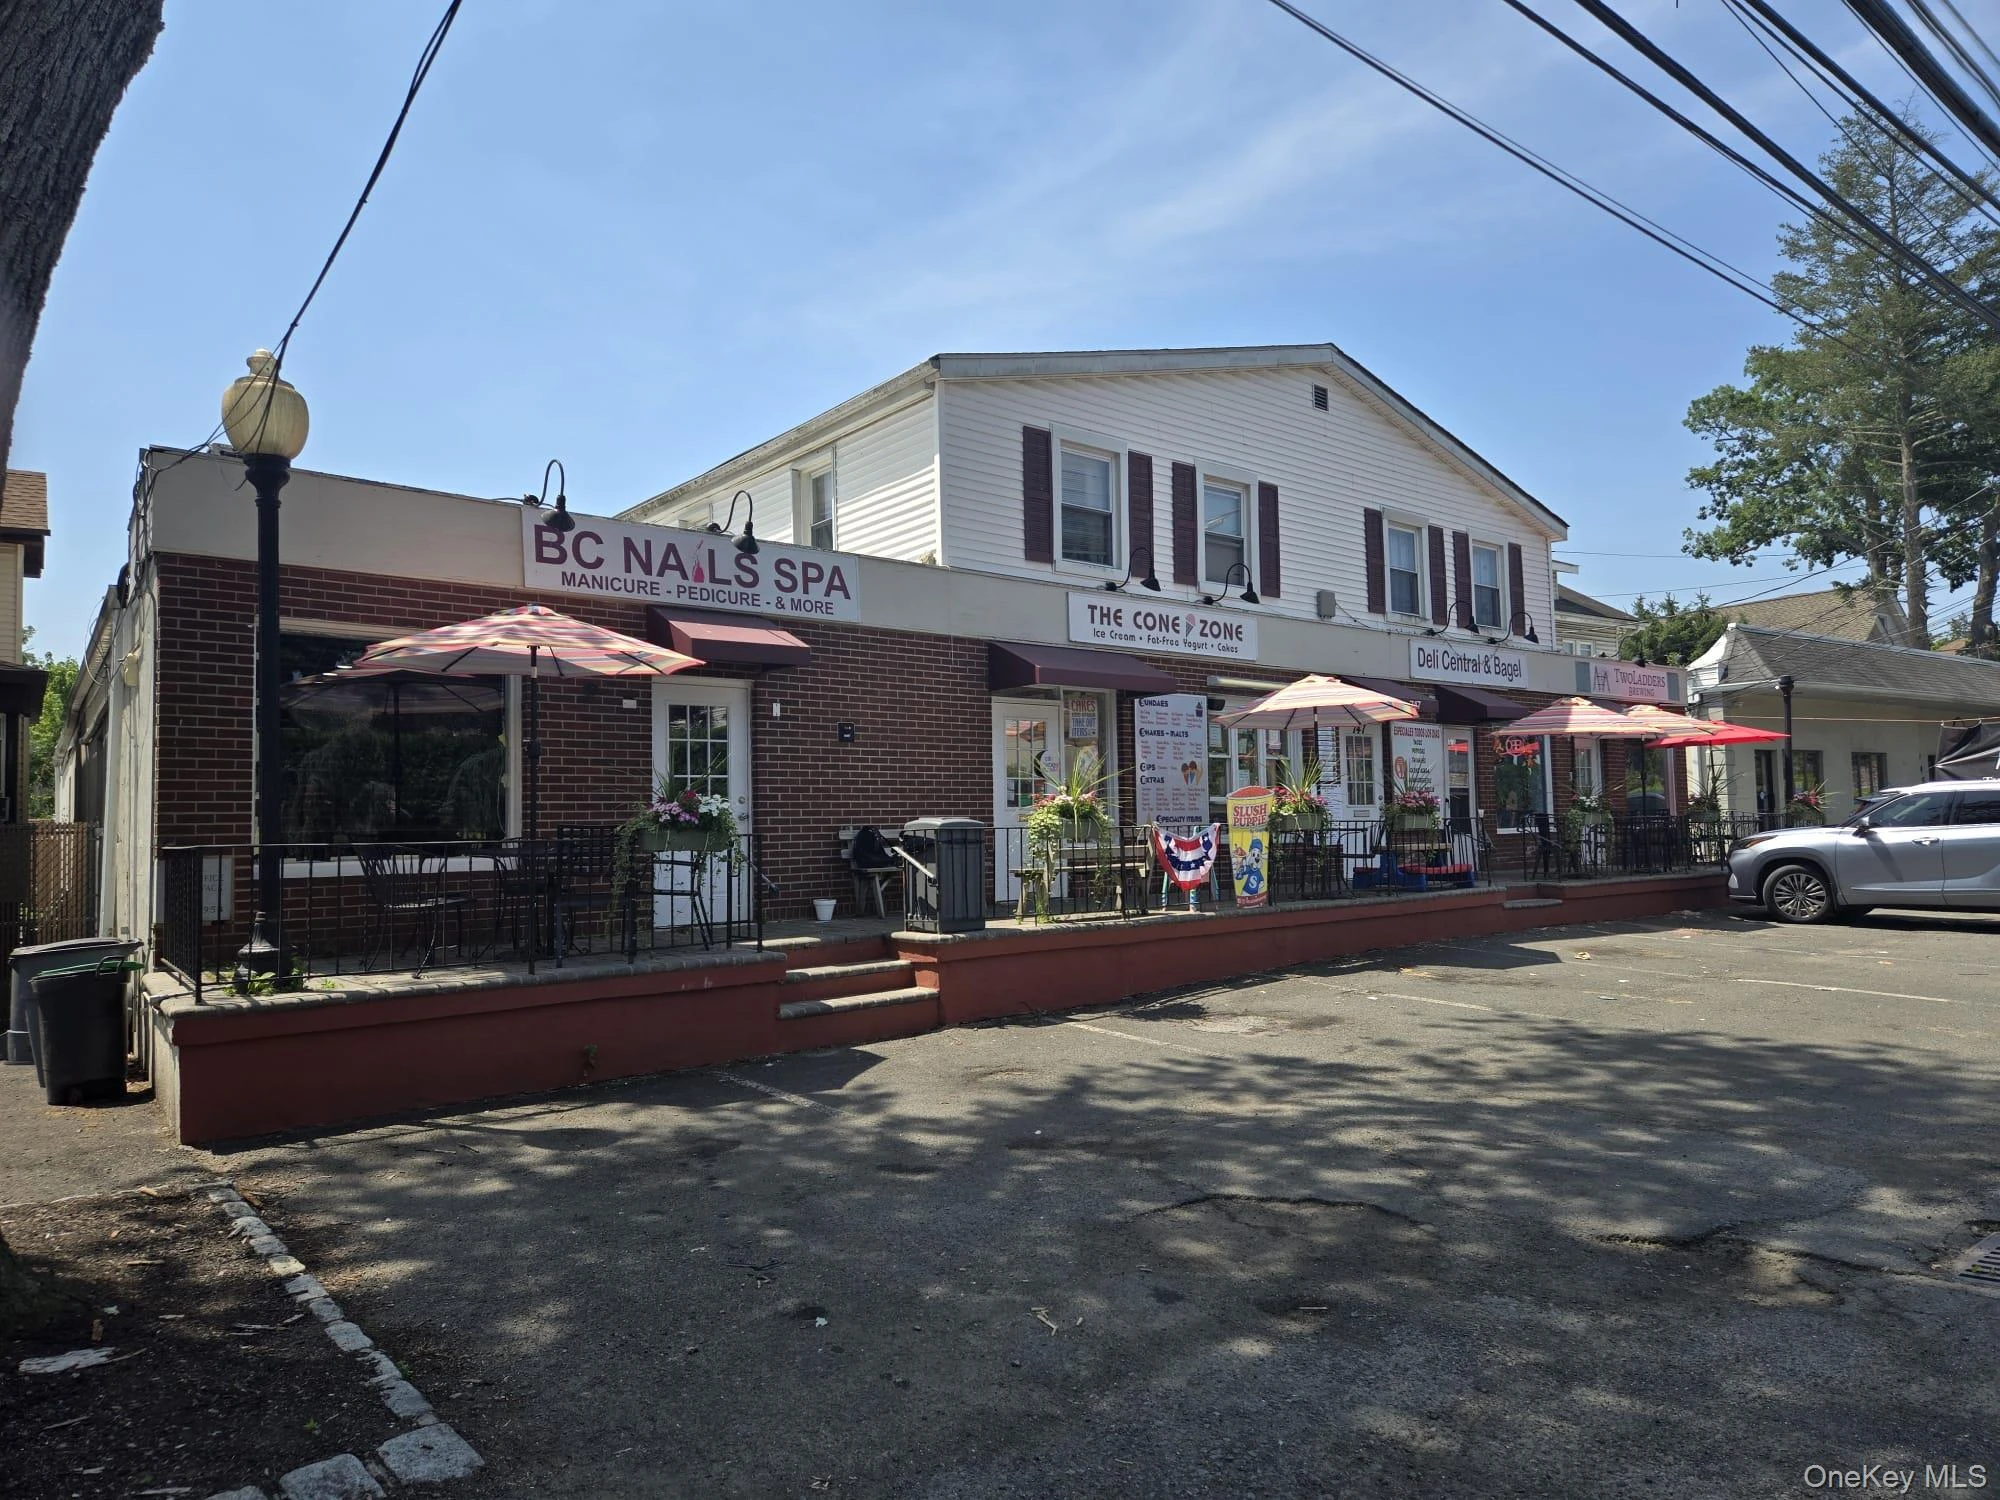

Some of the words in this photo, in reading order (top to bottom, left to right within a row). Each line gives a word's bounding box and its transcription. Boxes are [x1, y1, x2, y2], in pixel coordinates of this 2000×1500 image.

[534, 524, 605, 570] BC
[774, 557, 851, 601] SPA
[561, 571, 661, 596] MANICURE
[677, 584, 761, 607] PEDICURE
[775, 596, 786, 610] &
[790, 597, 834, 615] MORE
[1088, 604, 1123, 628] THE
[1133, 611, 1181, 634] CONE
[1199, 618, 1244, 641] ZONE
[1093, 627, 1106, 638] Ice
[1110, 630, 1136, 642] Cream
[1183, 638, 1208, 651] Yogurt
[1217, 642, 1239, 654] Cakes
[1417, 647, 1439, 669] Deli
[1441, 650, 1481, 674] Central
[1483, 654, 1492, 675] &
[1494, 656, 1522, 682] Bagel
[1628, 686, 1655, 697] BREWING
[1071, 699, 1096, 713] CAKES
[1232, 803, 1267, 818] SLUSH
[1233, 815, 1266, 828] PUPPIE
